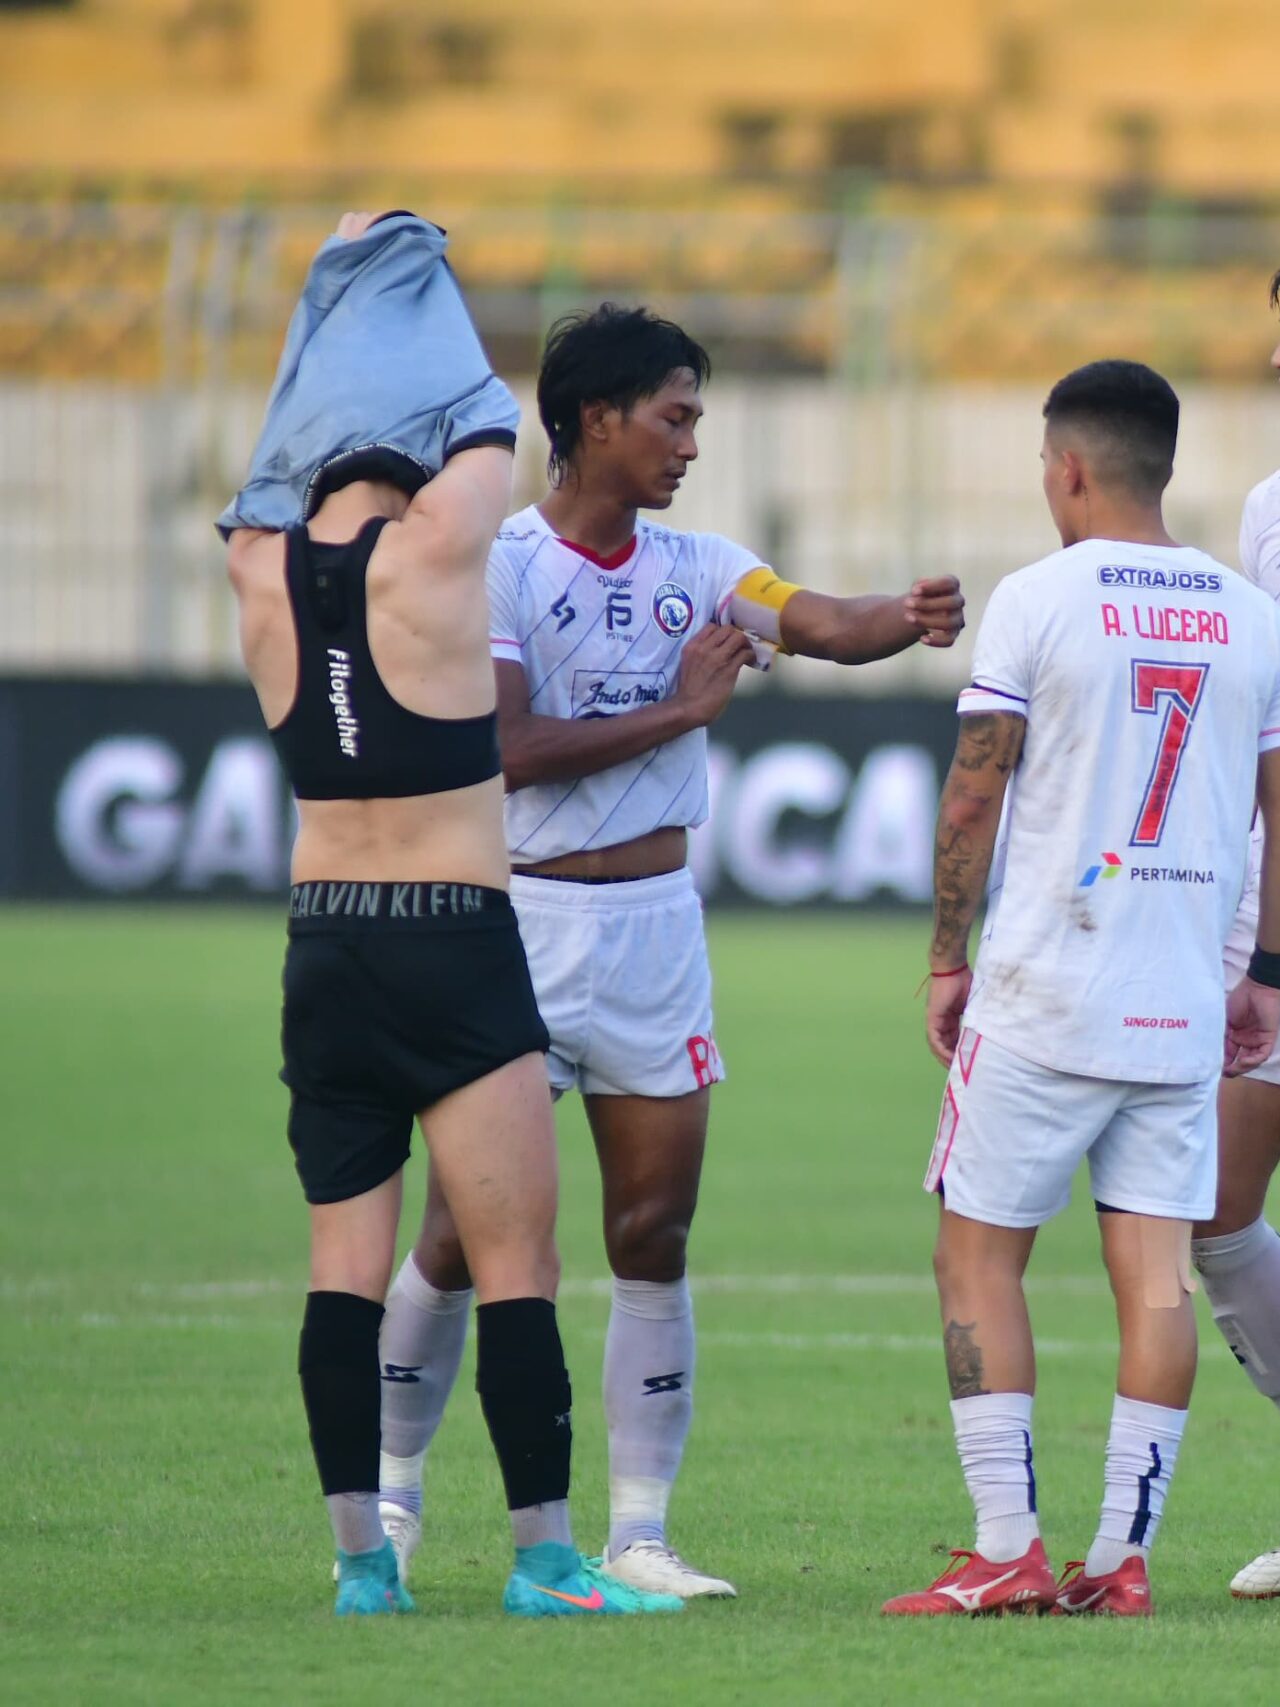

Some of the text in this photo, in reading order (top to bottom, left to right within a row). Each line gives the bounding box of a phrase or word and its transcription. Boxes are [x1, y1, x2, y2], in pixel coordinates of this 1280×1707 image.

[1099, 566, 1221, 591] EXTRAJOSS
[1101, 603, 1229, 645] A. LUCERO
[327, 648, 359, 758] Fitogether
[1129, 658, 1210, 847] 7
[1130, 867, 1215, 884] PERTAMINA
[1122, 1017, 1189, 1029] SINGO EDAN
